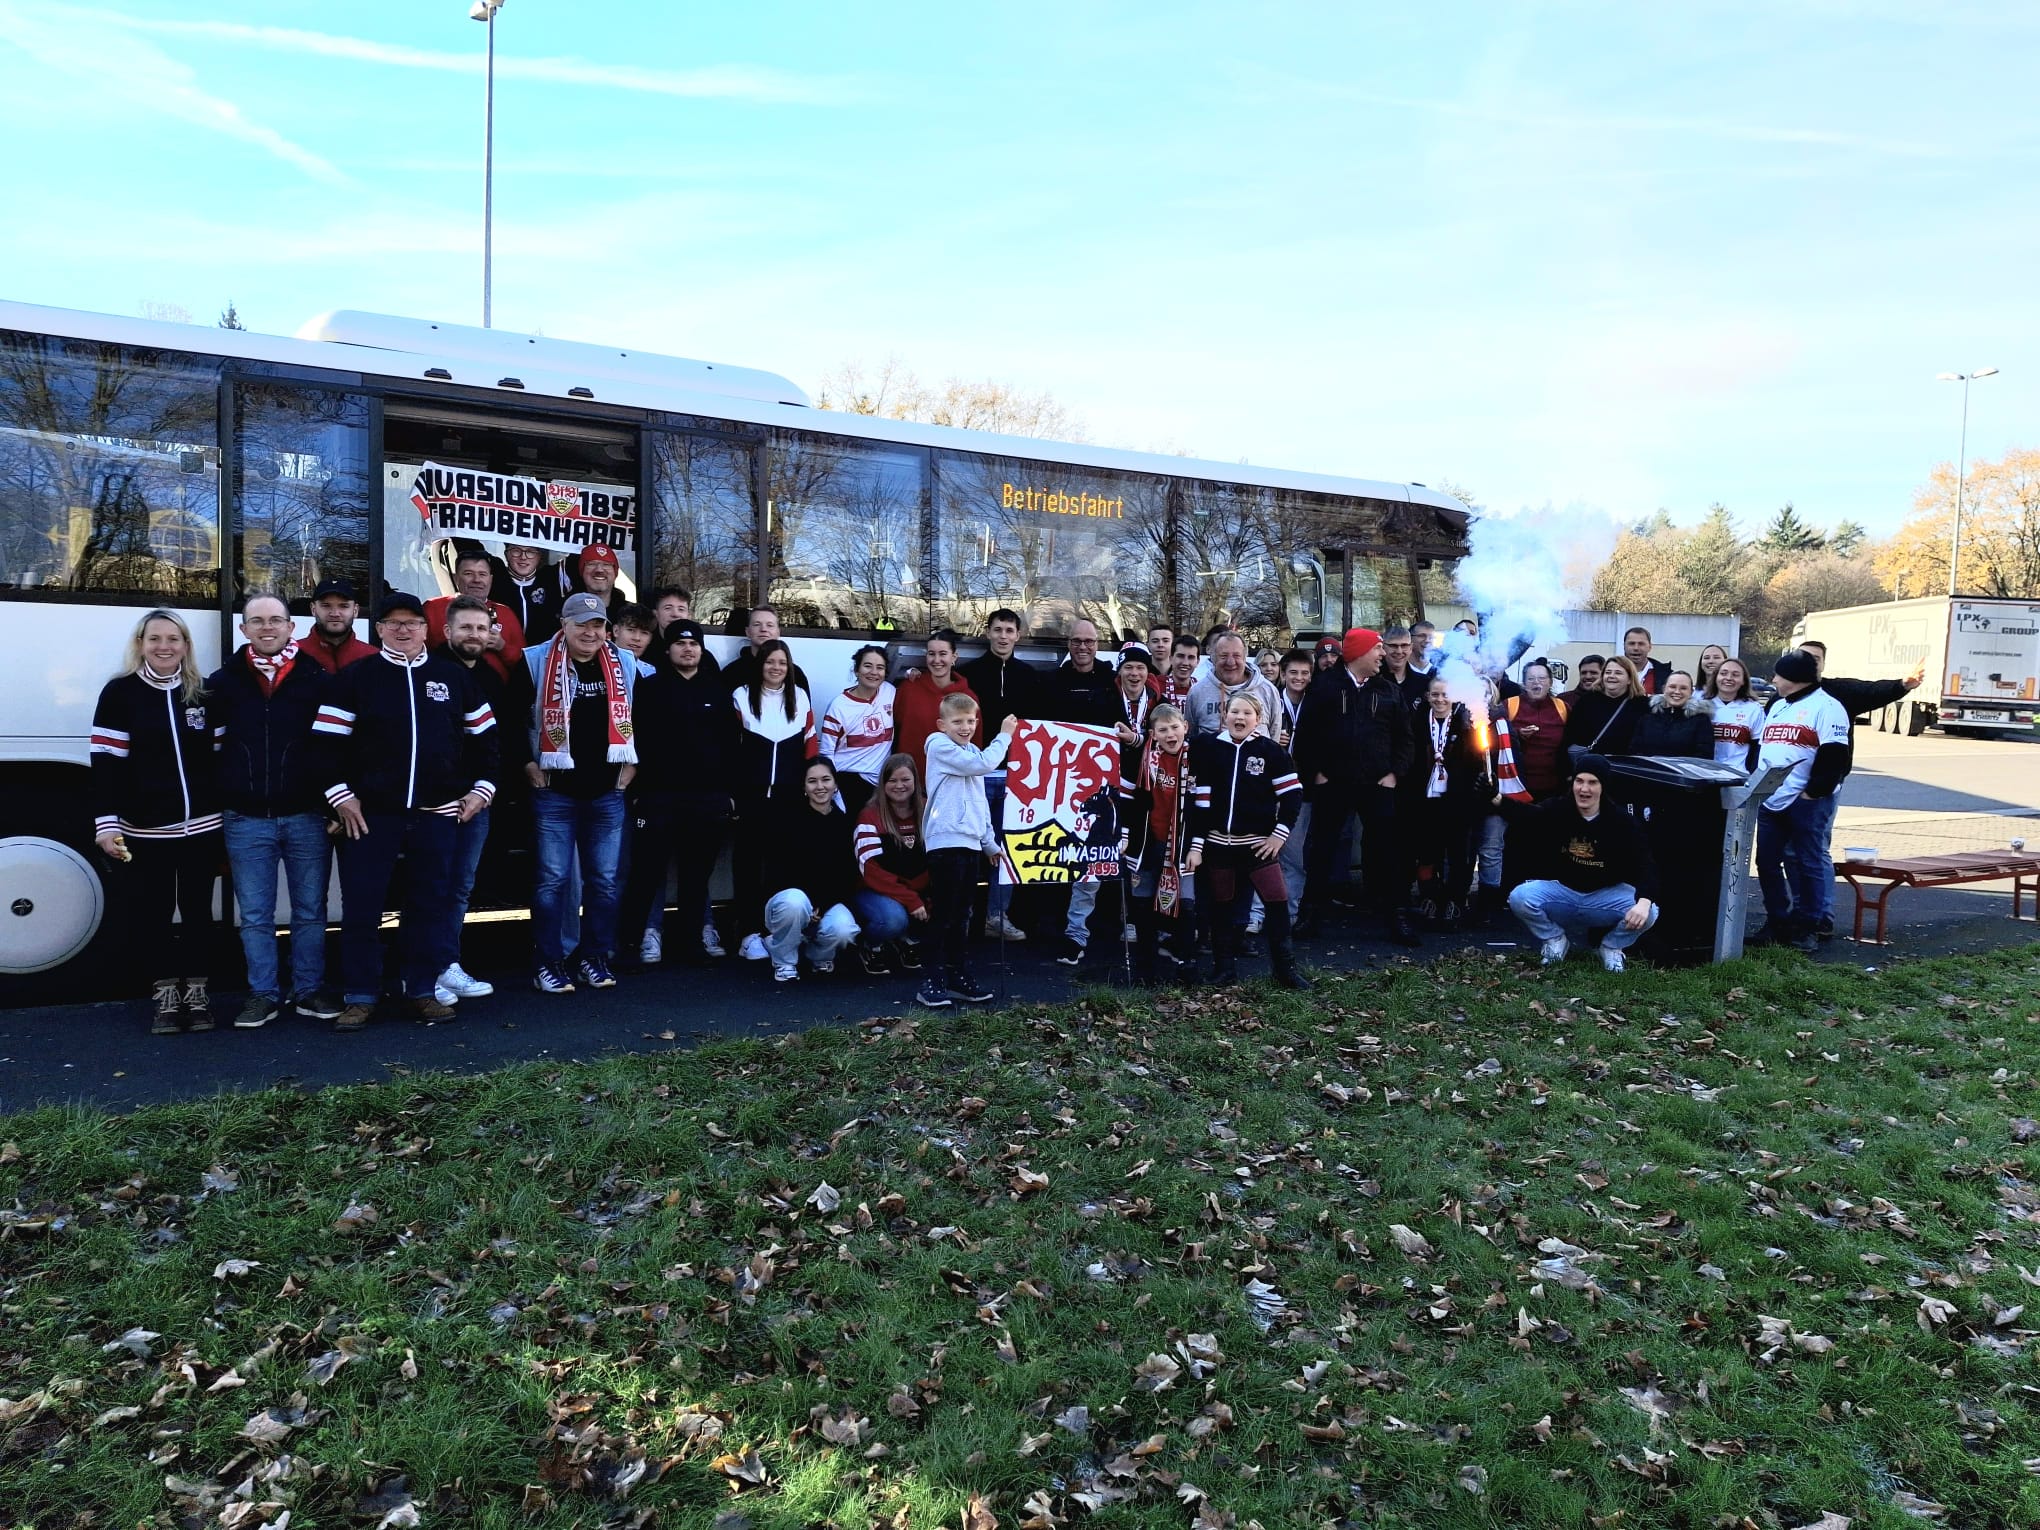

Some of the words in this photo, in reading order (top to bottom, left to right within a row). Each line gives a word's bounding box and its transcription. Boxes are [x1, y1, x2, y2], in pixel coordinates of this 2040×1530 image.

[1003, 483, 1123, 518] Betriebsfahrt
[2001, 627, 2040, 635] GROUP
[1018, 807, 1035, 824] 18
[1074, 817, 1091, 832] 93
[1058, 845, 1120, 863] INVASION
[1087, 862, 1120, 876] 1893
